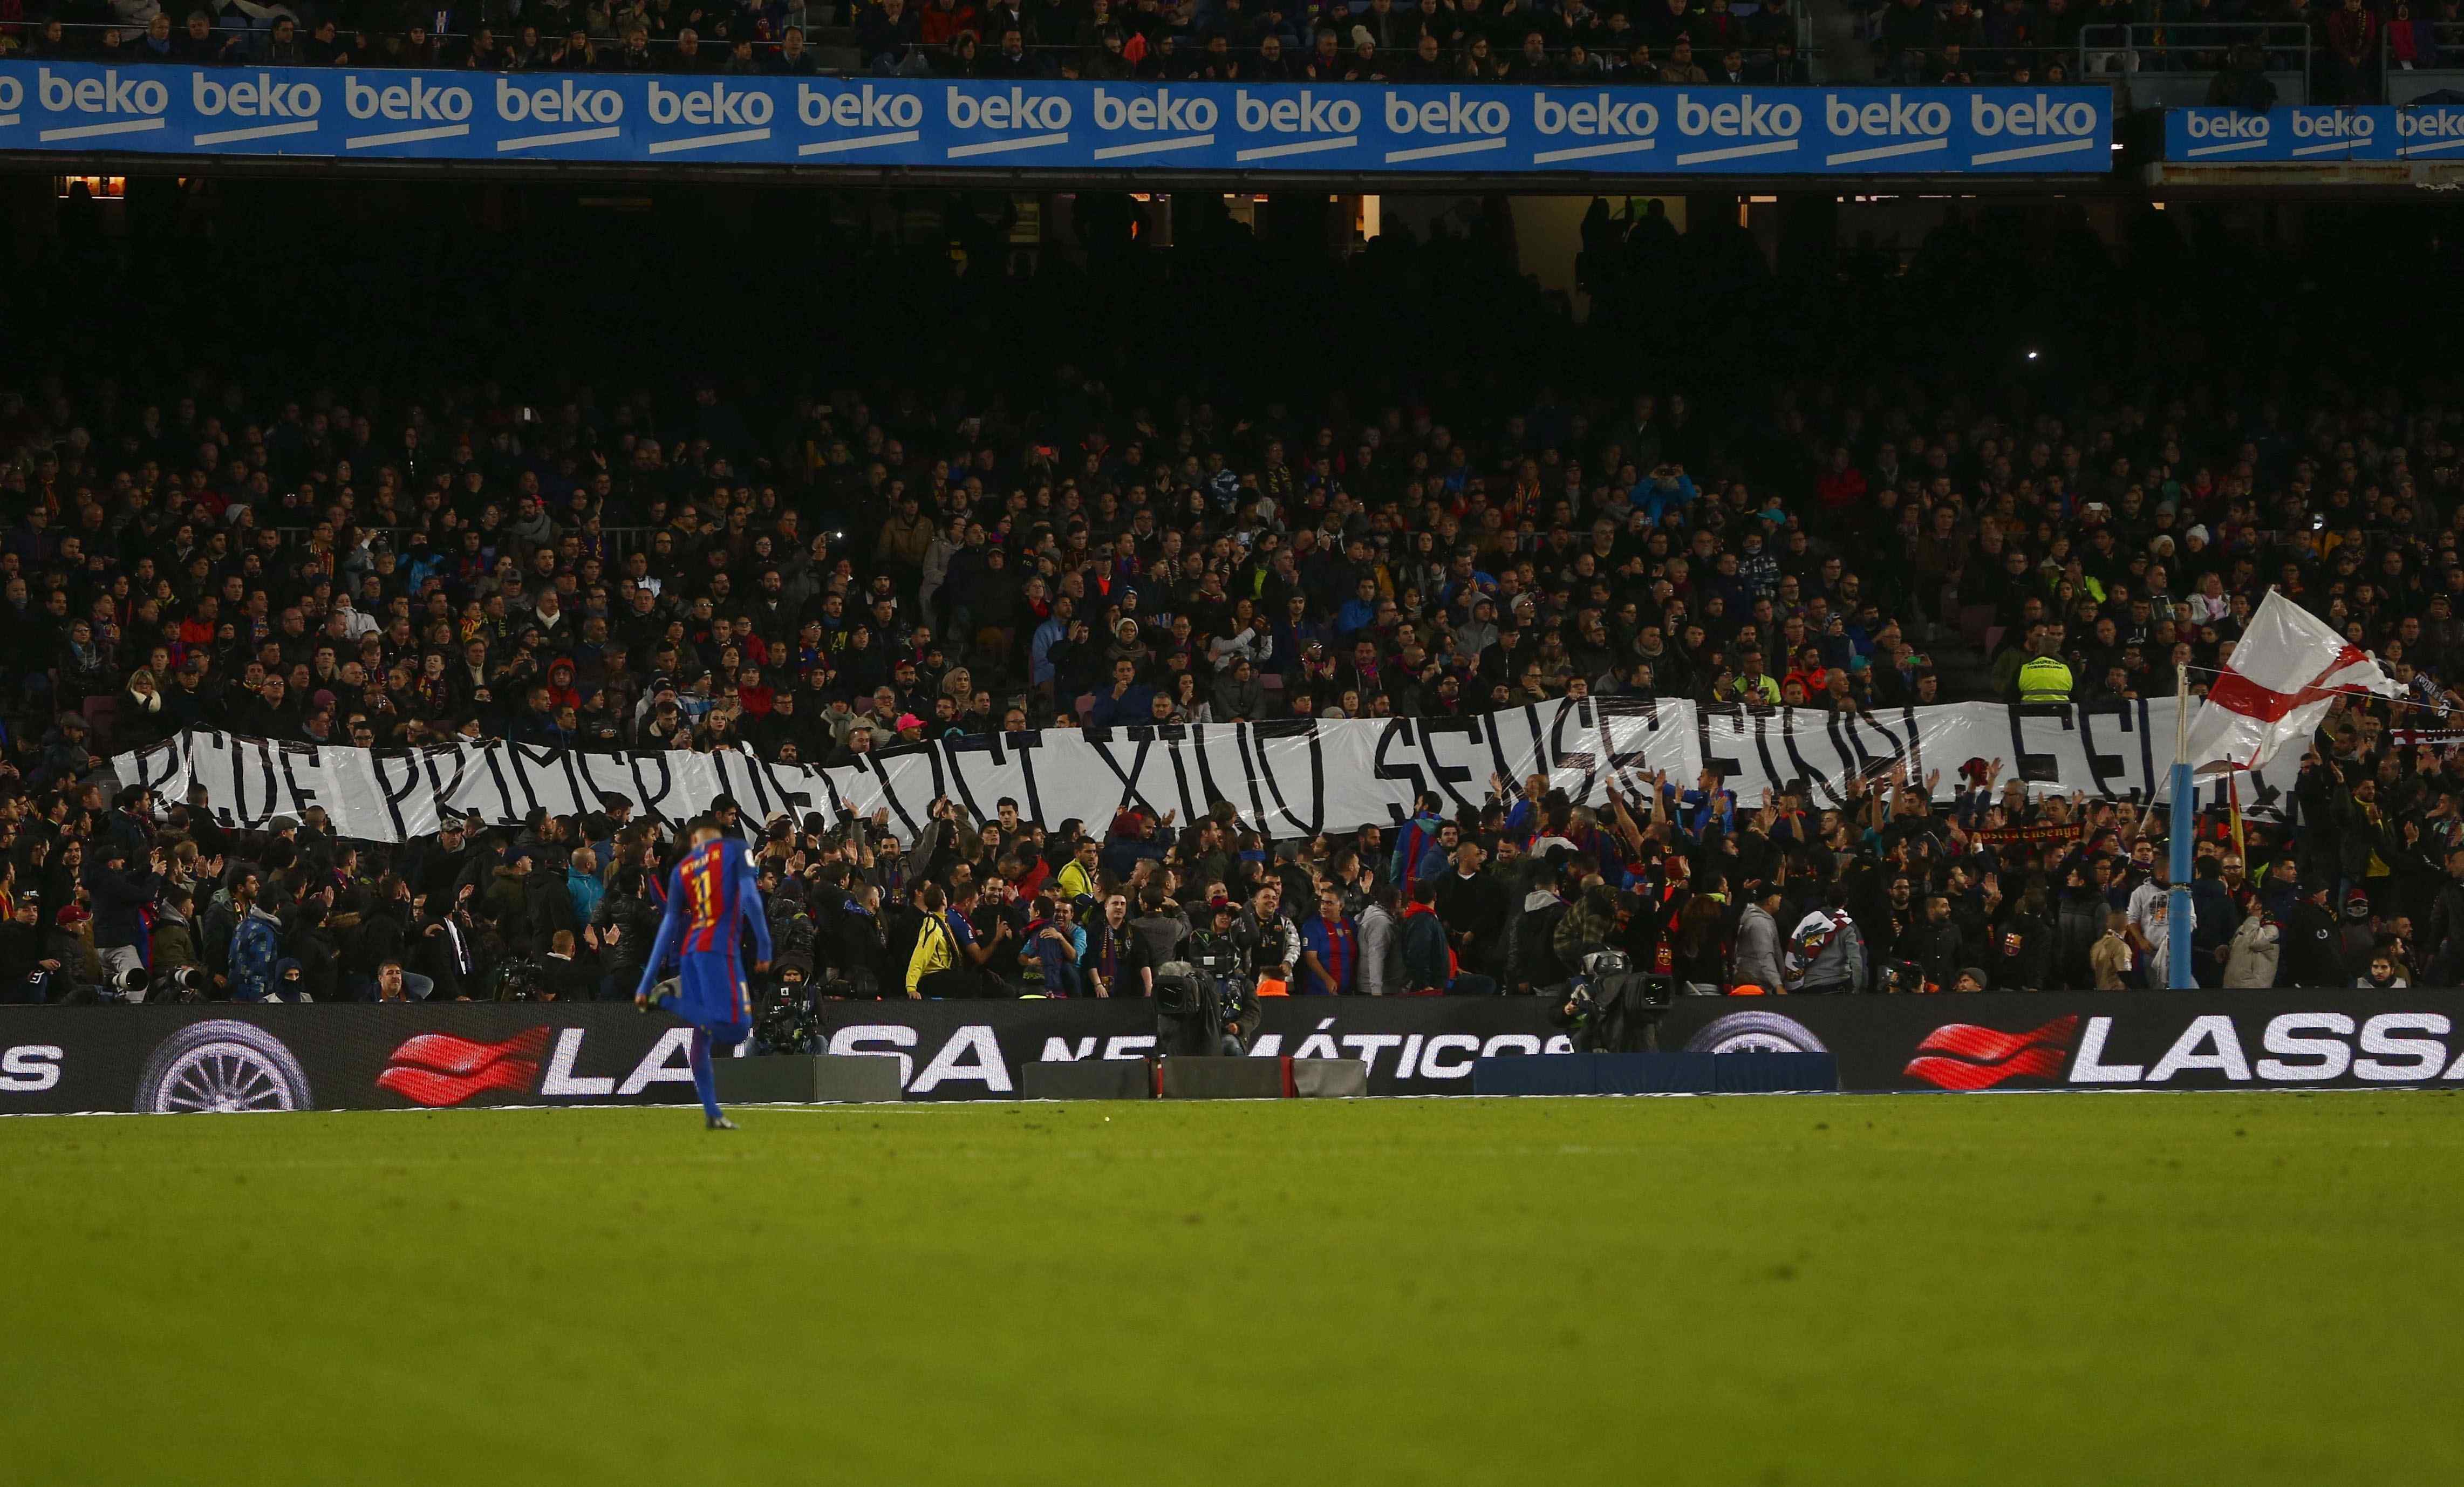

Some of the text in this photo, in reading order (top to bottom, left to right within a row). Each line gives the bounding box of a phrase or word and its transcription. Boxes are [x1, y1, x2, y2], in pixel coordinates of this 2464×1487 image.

[39, 68, 167, 114] beko
[193, 72, 321, 117] beko
[346, 76, 472, 120] beko
[497, 79, 623, 123] beko
[649, 81, 773, 125] beko
[798, 84, 922, 127] beko
[947, 86, 1071, 129] beko
[1094, 88, 1218, 131] beko
[1237, 90, 1361, 132] beko
[1386, 92, 1510, 134] beko
[1535, 93, 1658, 135] beko
[1678, 94, 1801, 135] beko
[1827, 94, 1950, 135] beko
[1972, 94, 2096, 135] beko
[2188, 111, 2269, 137] beko
[2294, 110, 2373, 137] beko
[541, 1025, 1014, 1095] LASA
